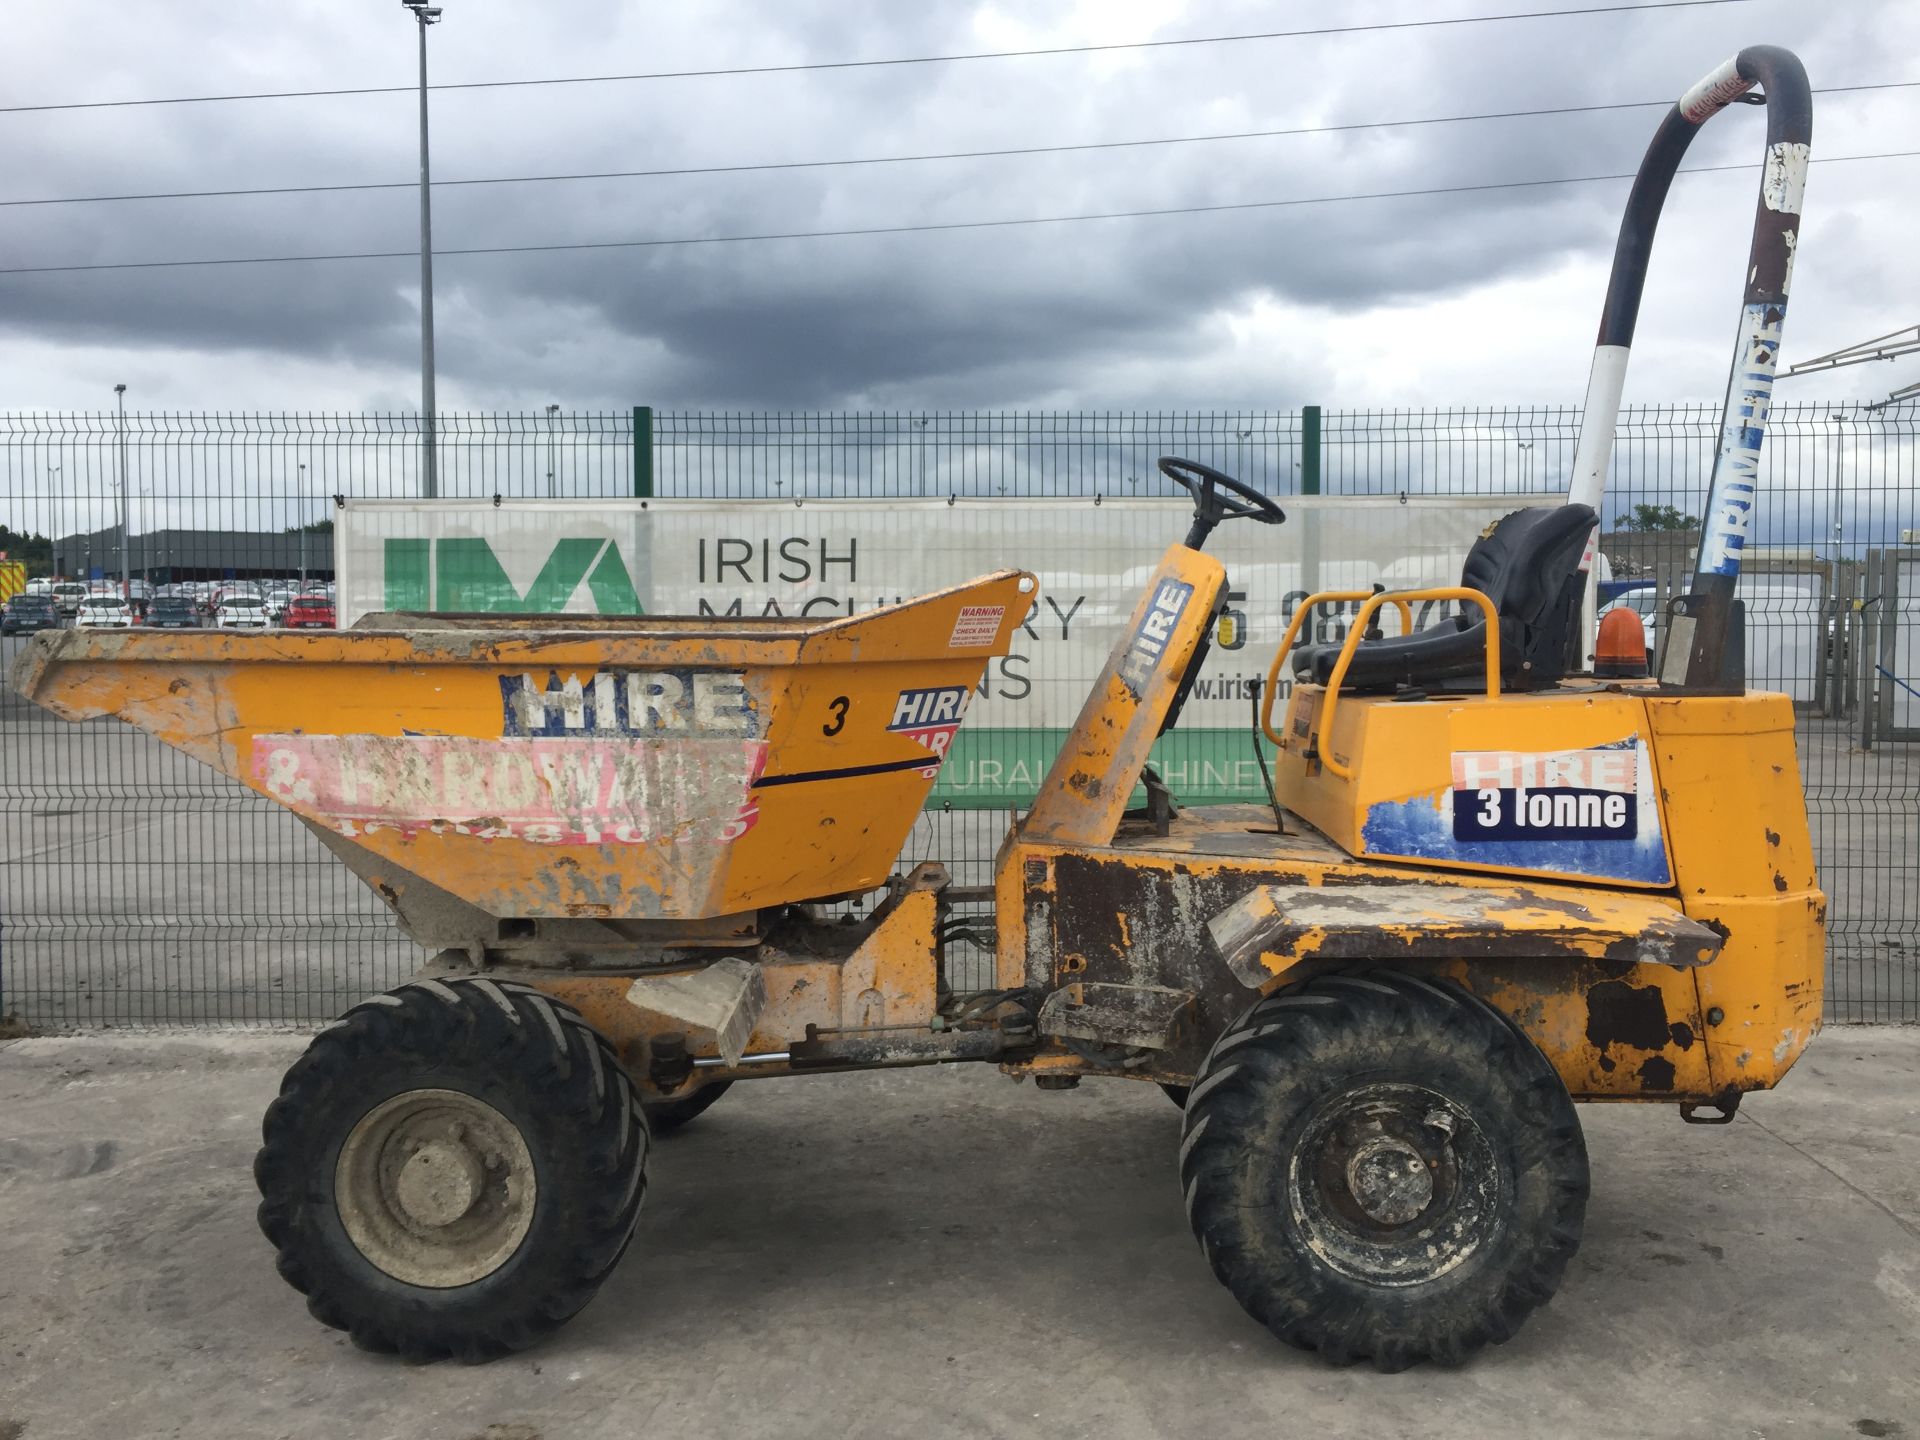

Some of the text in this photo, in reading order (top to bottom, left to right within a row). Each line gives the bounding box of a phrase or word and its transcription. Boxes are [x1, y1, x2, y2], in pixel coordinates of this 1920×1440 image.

[1711, 450, 1762, 568] TRIM
[699, 537, 857, 584] IRISH
[961, 607, 1005, 616] WARNING
[1123, 584, 1188, 684] HIRE
[520, 671, 749, 729] HIRE
[822, 696, 850, 737] 3
[266, 748, 318, 804] &
[1464, 755, 1627, 791] HIRE
[1477, 788, 1502, 828] 3
